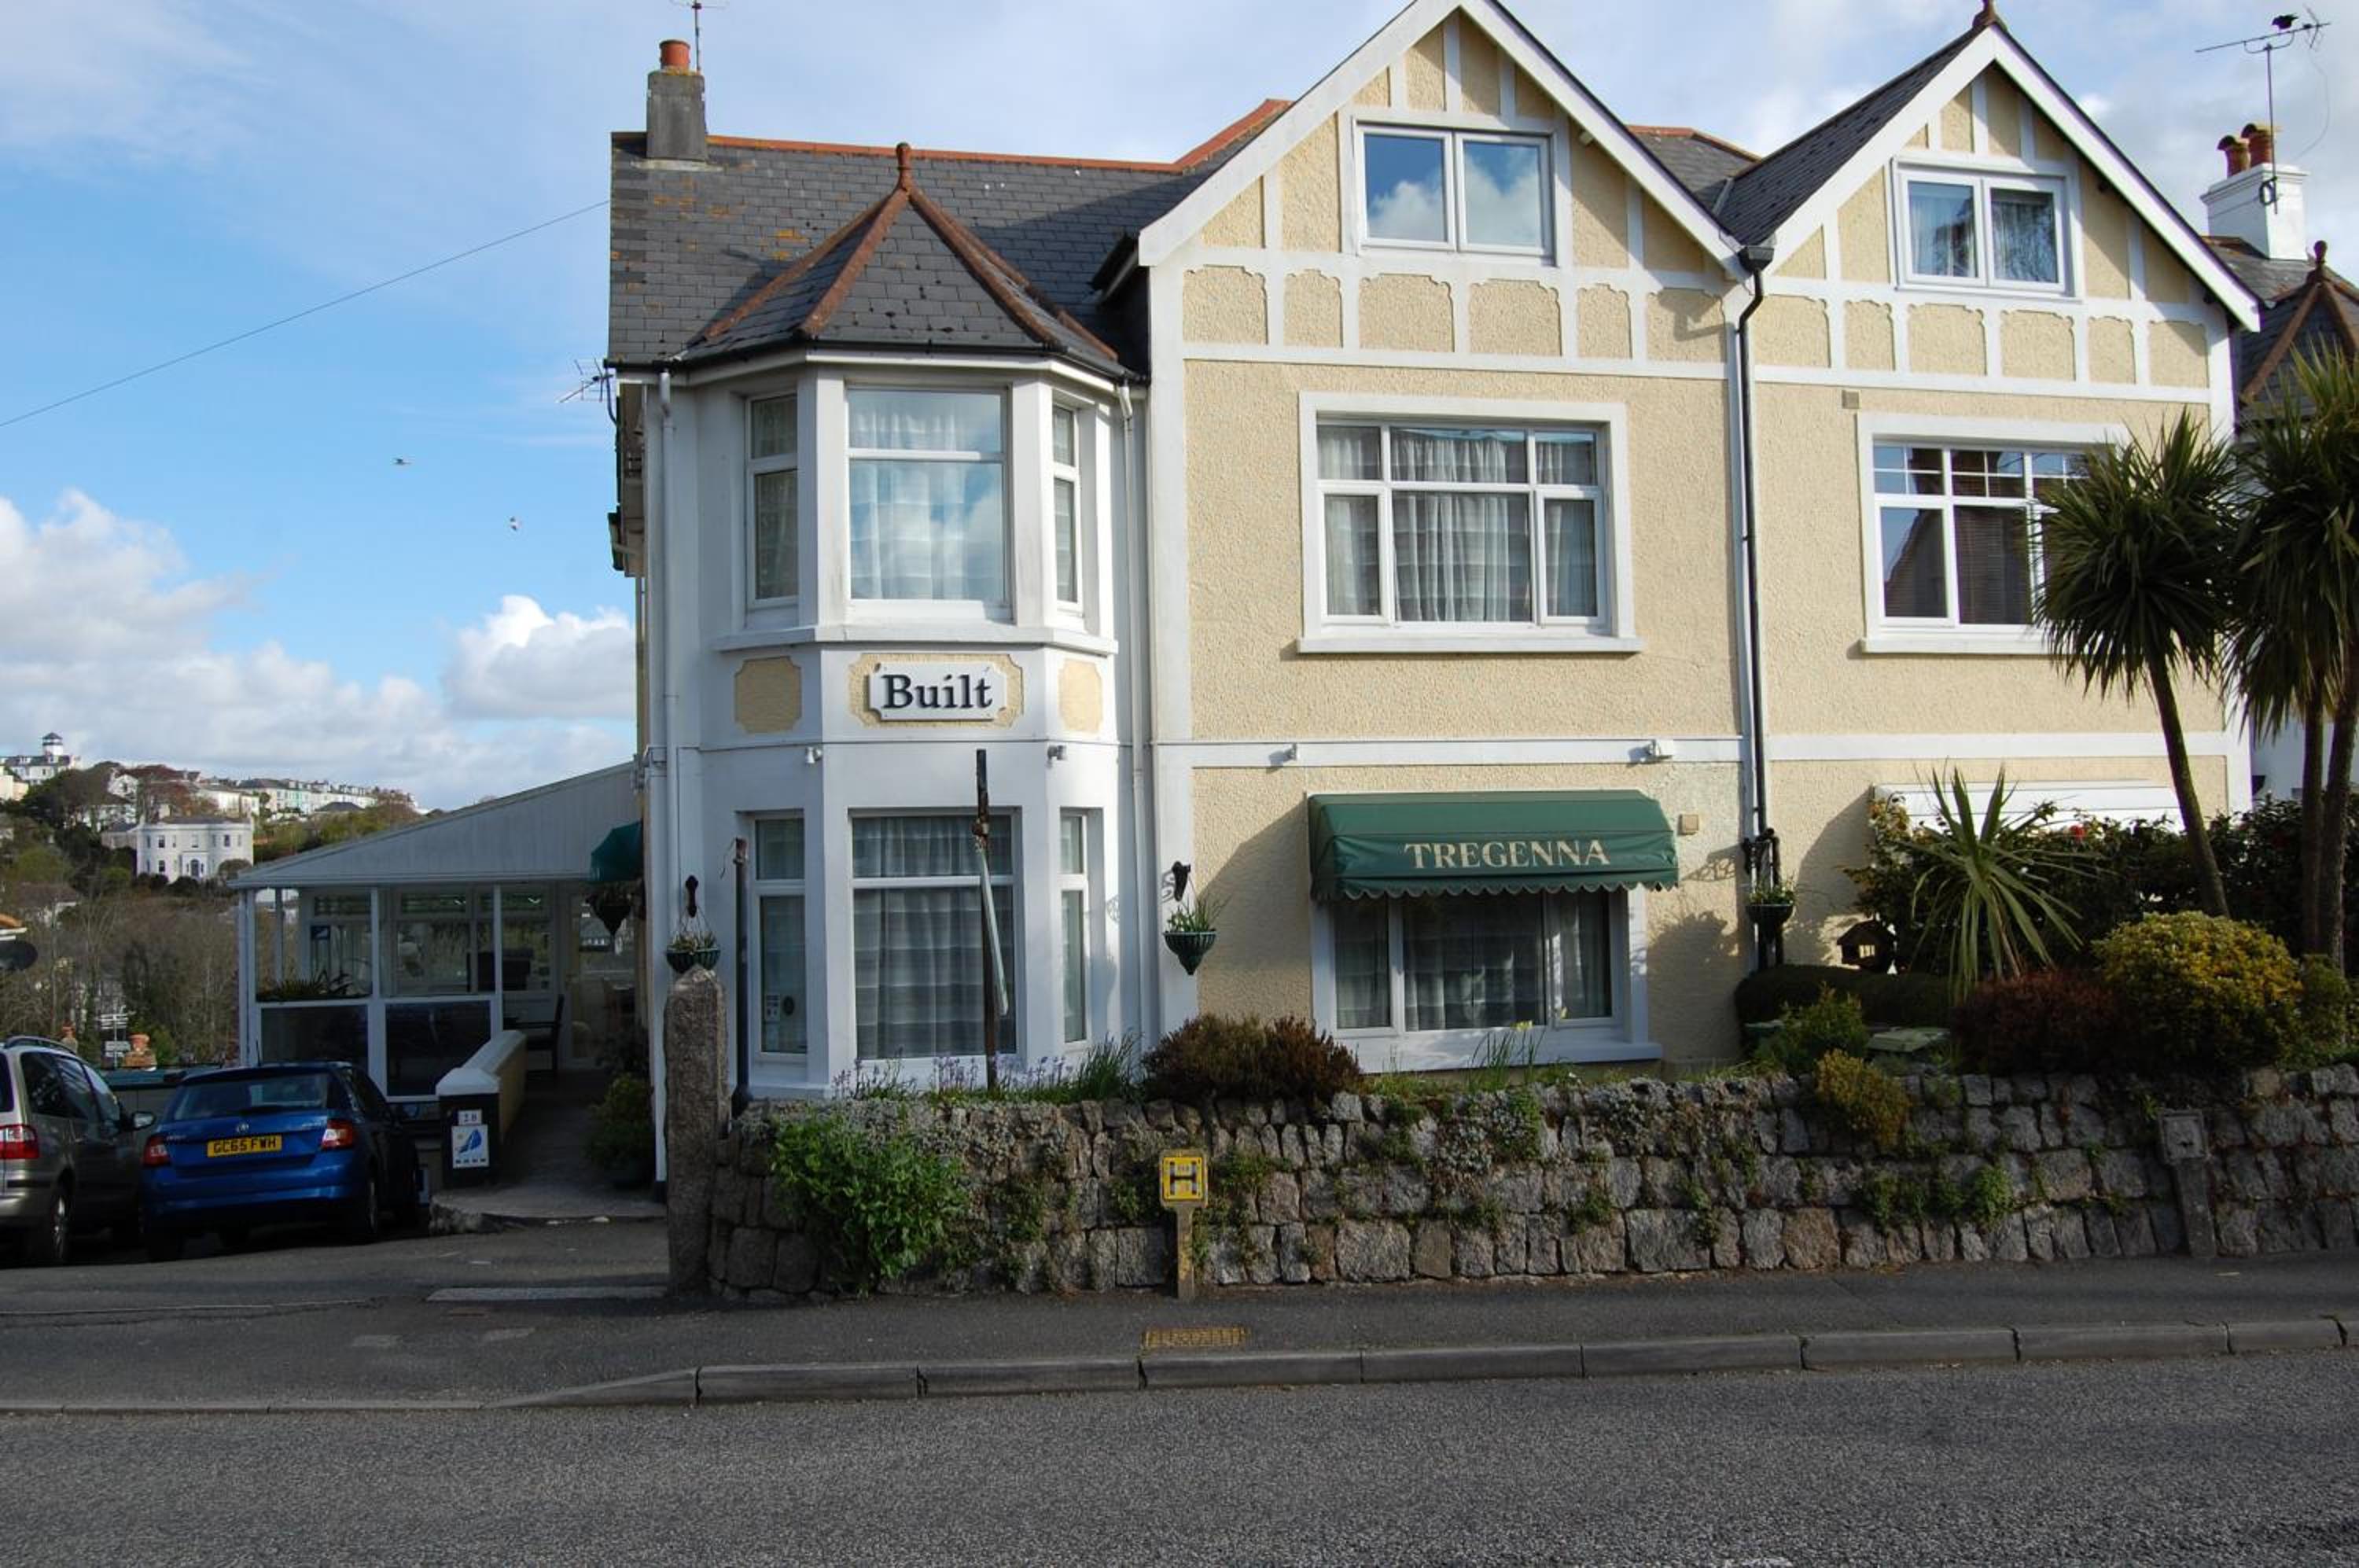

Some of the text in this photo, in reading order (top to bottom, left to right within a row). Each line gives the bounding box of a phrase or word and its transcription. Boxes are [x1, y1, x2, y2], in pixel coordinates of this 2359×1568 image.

[881, 674, 993, 709] Built
[1403, 839, 1610, 869] TREGENNA
[1169, 1161, 1198, 1195] H
